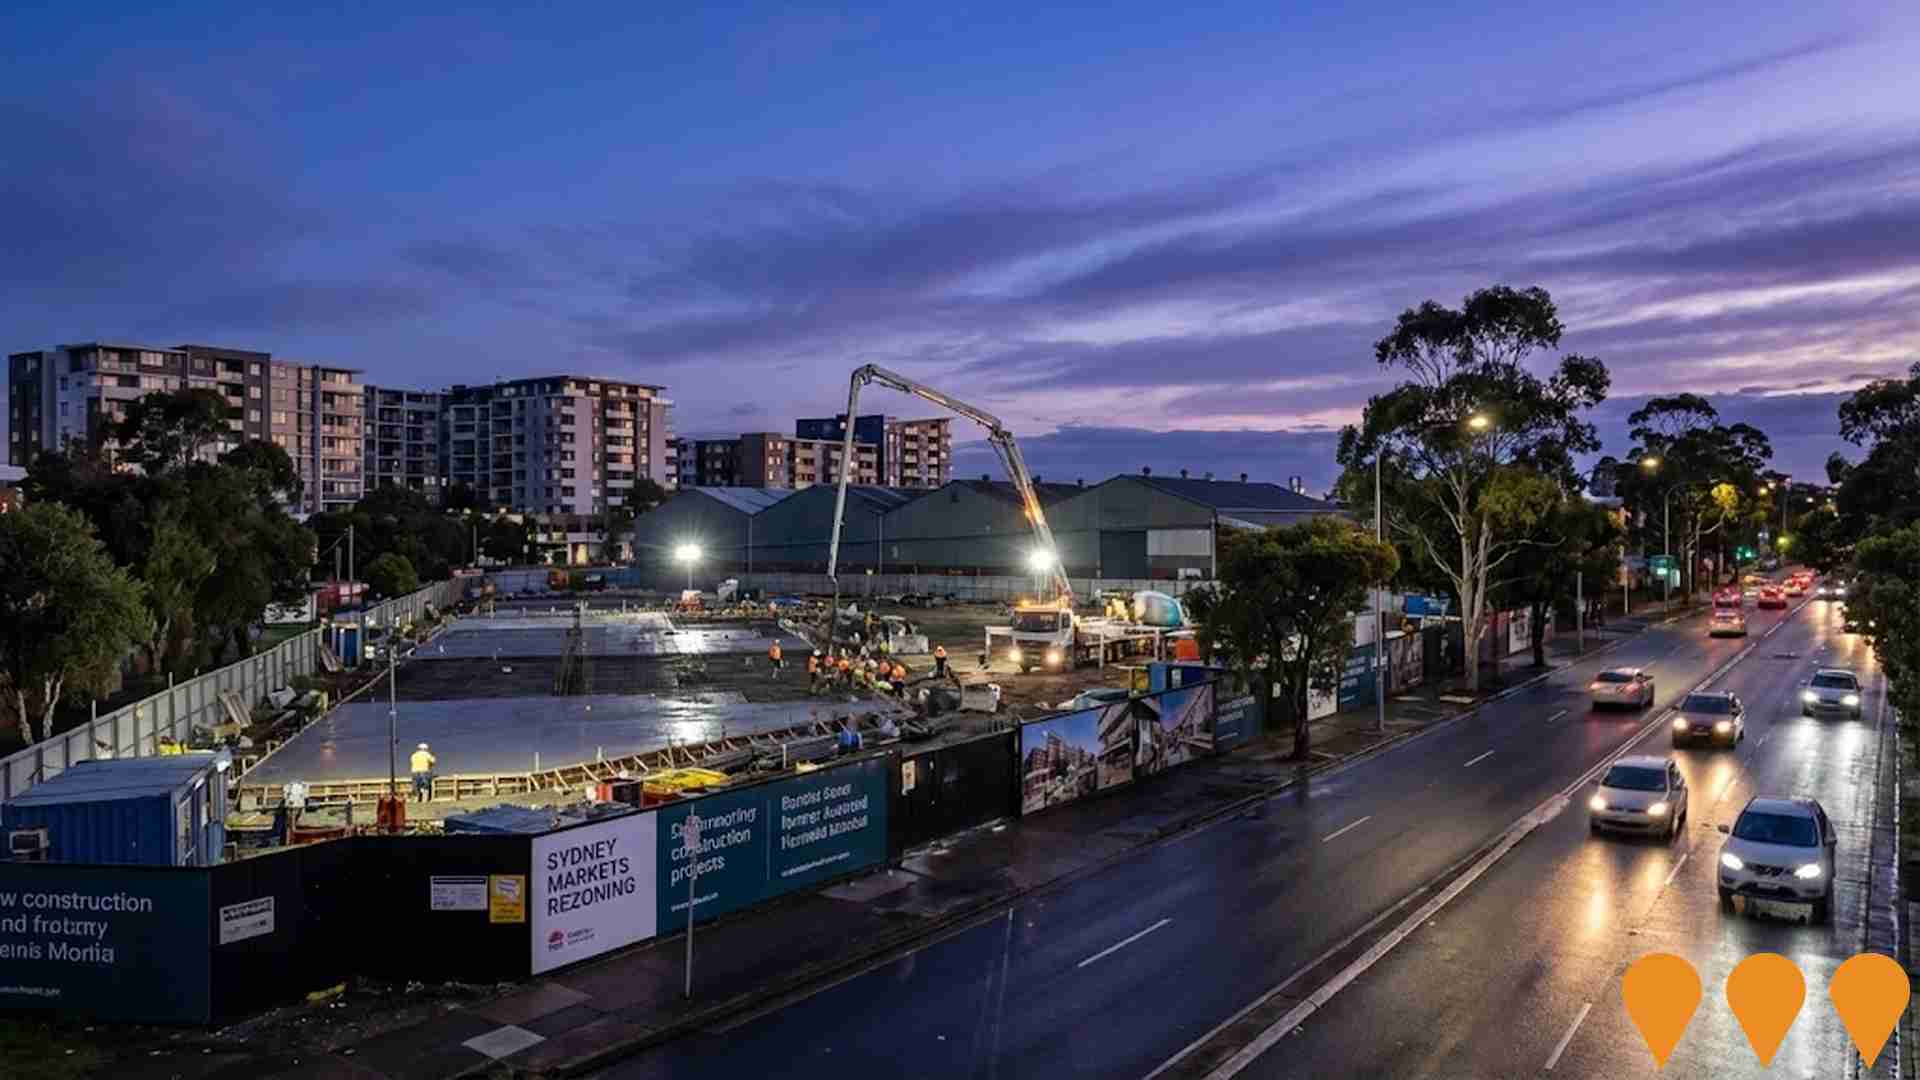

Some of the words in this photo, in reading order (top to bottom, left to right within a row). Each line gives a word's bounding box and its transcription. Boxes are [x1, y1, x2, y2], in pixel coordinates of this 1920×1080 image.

[547, 838, 617, 871] SYDNEY
[672, 829, 751, 861] costruction
[547, 857, 630, 894] MARKETS
[22, 892, 153, 912] construction
[547, 876, 636, 917] REZONING
